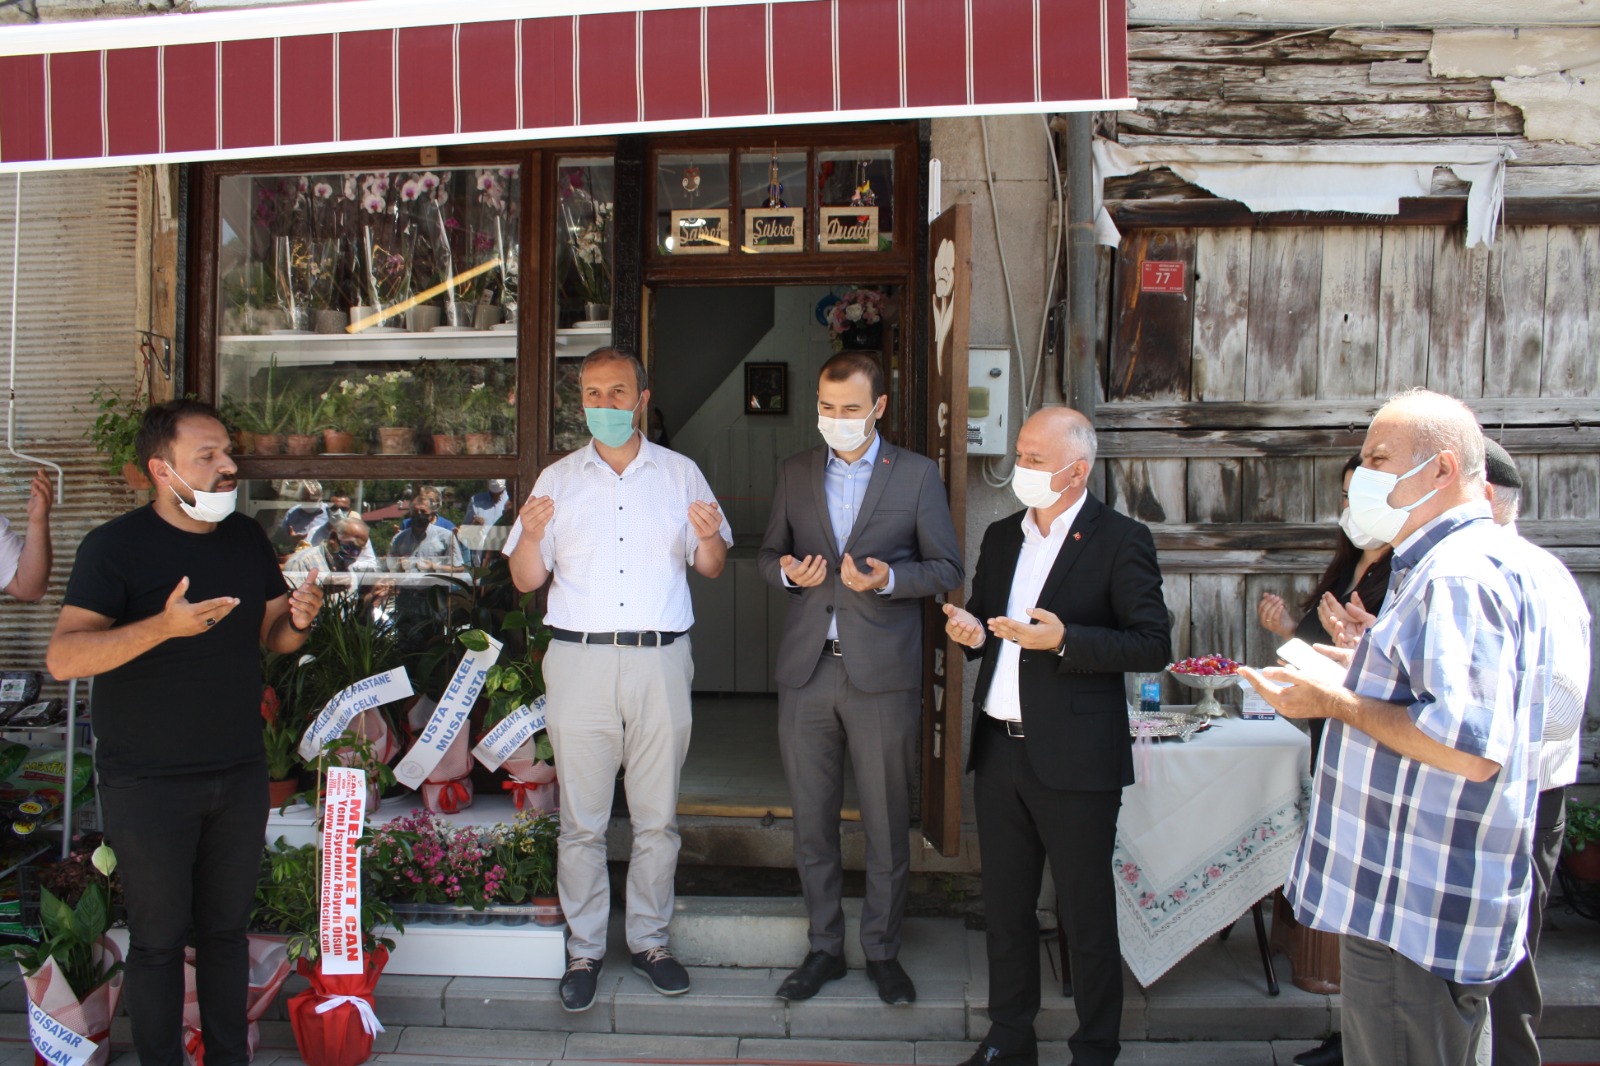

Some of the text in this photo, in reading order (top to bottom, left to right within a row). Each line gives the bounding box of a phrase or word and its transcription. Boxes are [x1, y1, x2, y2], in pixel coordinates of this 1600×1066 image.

[1155, 272, 1170, 284] 77
[353, 673, 392, 695] PASTANE
[420, 657, 475, 744] USTA TEKEL
[435, 669, 487, 752] MUSA USTA
[336, 800, 348, 826] Yeni
[333, 829, 347, 881] İşyeriniz
[322, 804, 334, 953] www.mudurnucicekcilik.com
[345, 799, 361, 961] MEHMET CAN
[333, 883, 343, 923] Hayırlı
[332, 927, 343, 956] Olsun
